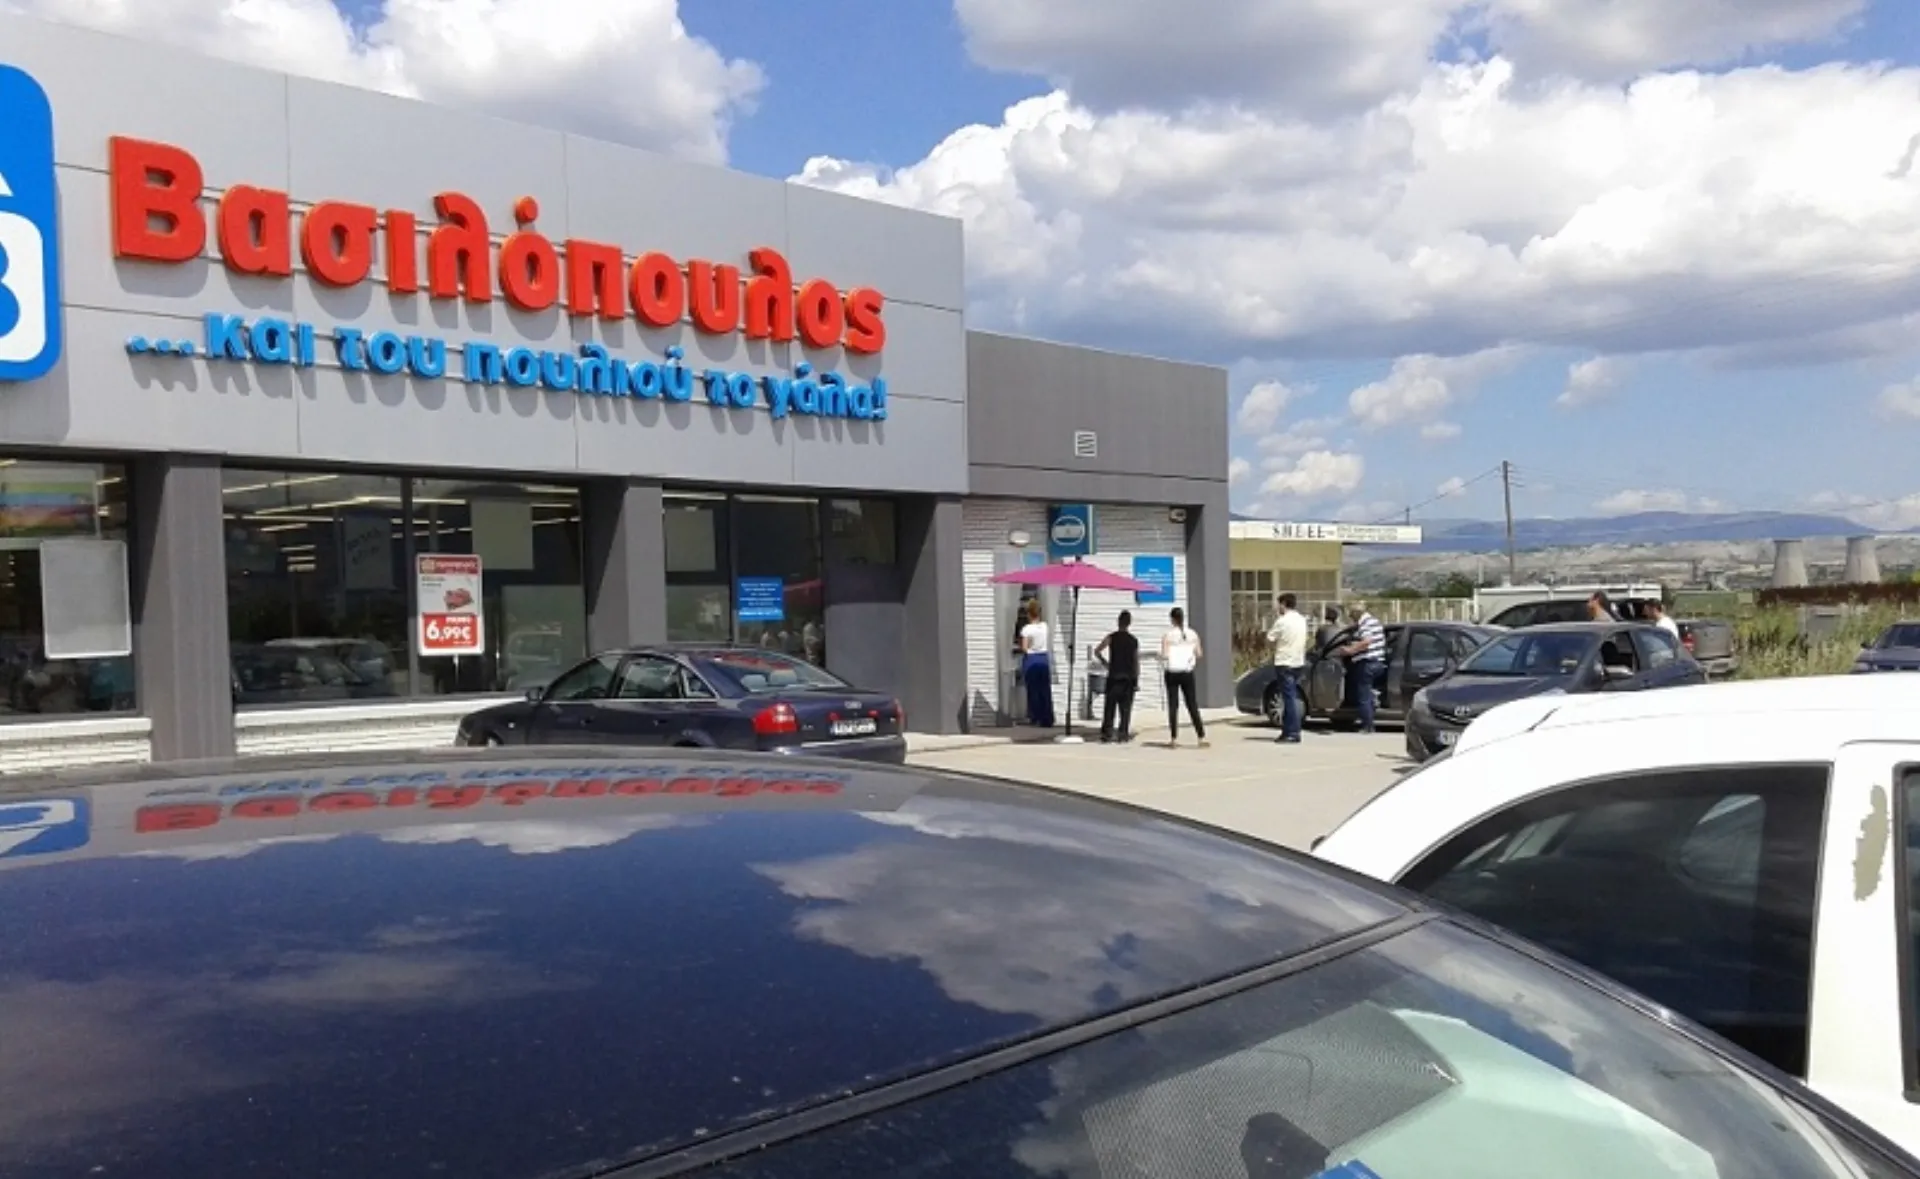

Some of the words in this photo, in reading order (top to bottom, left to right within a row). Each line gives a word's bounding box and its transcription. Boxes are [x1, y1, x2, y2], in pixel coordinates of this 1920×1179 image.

[110, 135, 886, 354] Βασιλόπουλος
[334, 326, 445, 379] του
[463, 341, 692, 401] πουλιού
[704, 369, 756, 408] το
[763, 362, 888, 420] γάλα!
[426, 619, 472, 643] 6,99€
